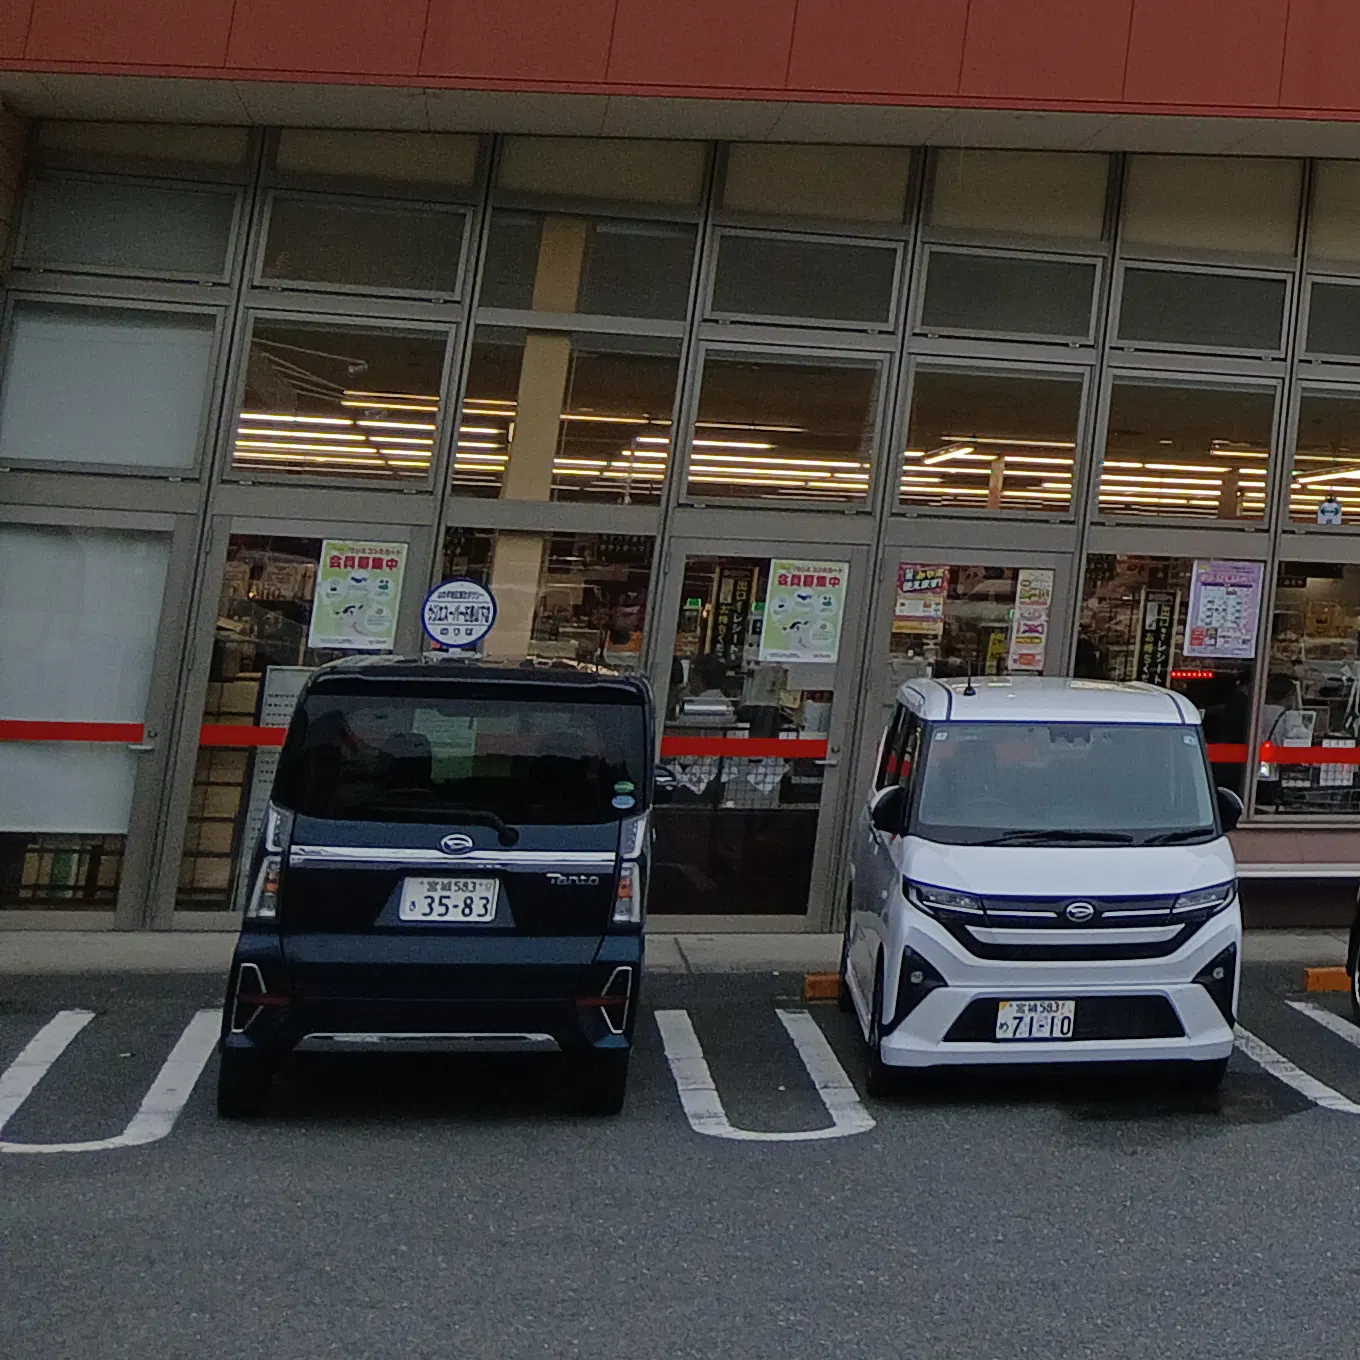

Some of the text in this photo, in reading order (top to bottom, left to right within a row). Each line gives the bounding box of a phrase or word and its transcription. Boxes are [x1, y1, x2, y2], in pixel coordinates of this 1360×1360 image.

[778, 573, 841, 588] 会員募集中
[546, 873, 600, 886] Tanto
[421, 895, 491, 918] 35-83
[1012, 1015, 1072, 1038] 71-10
